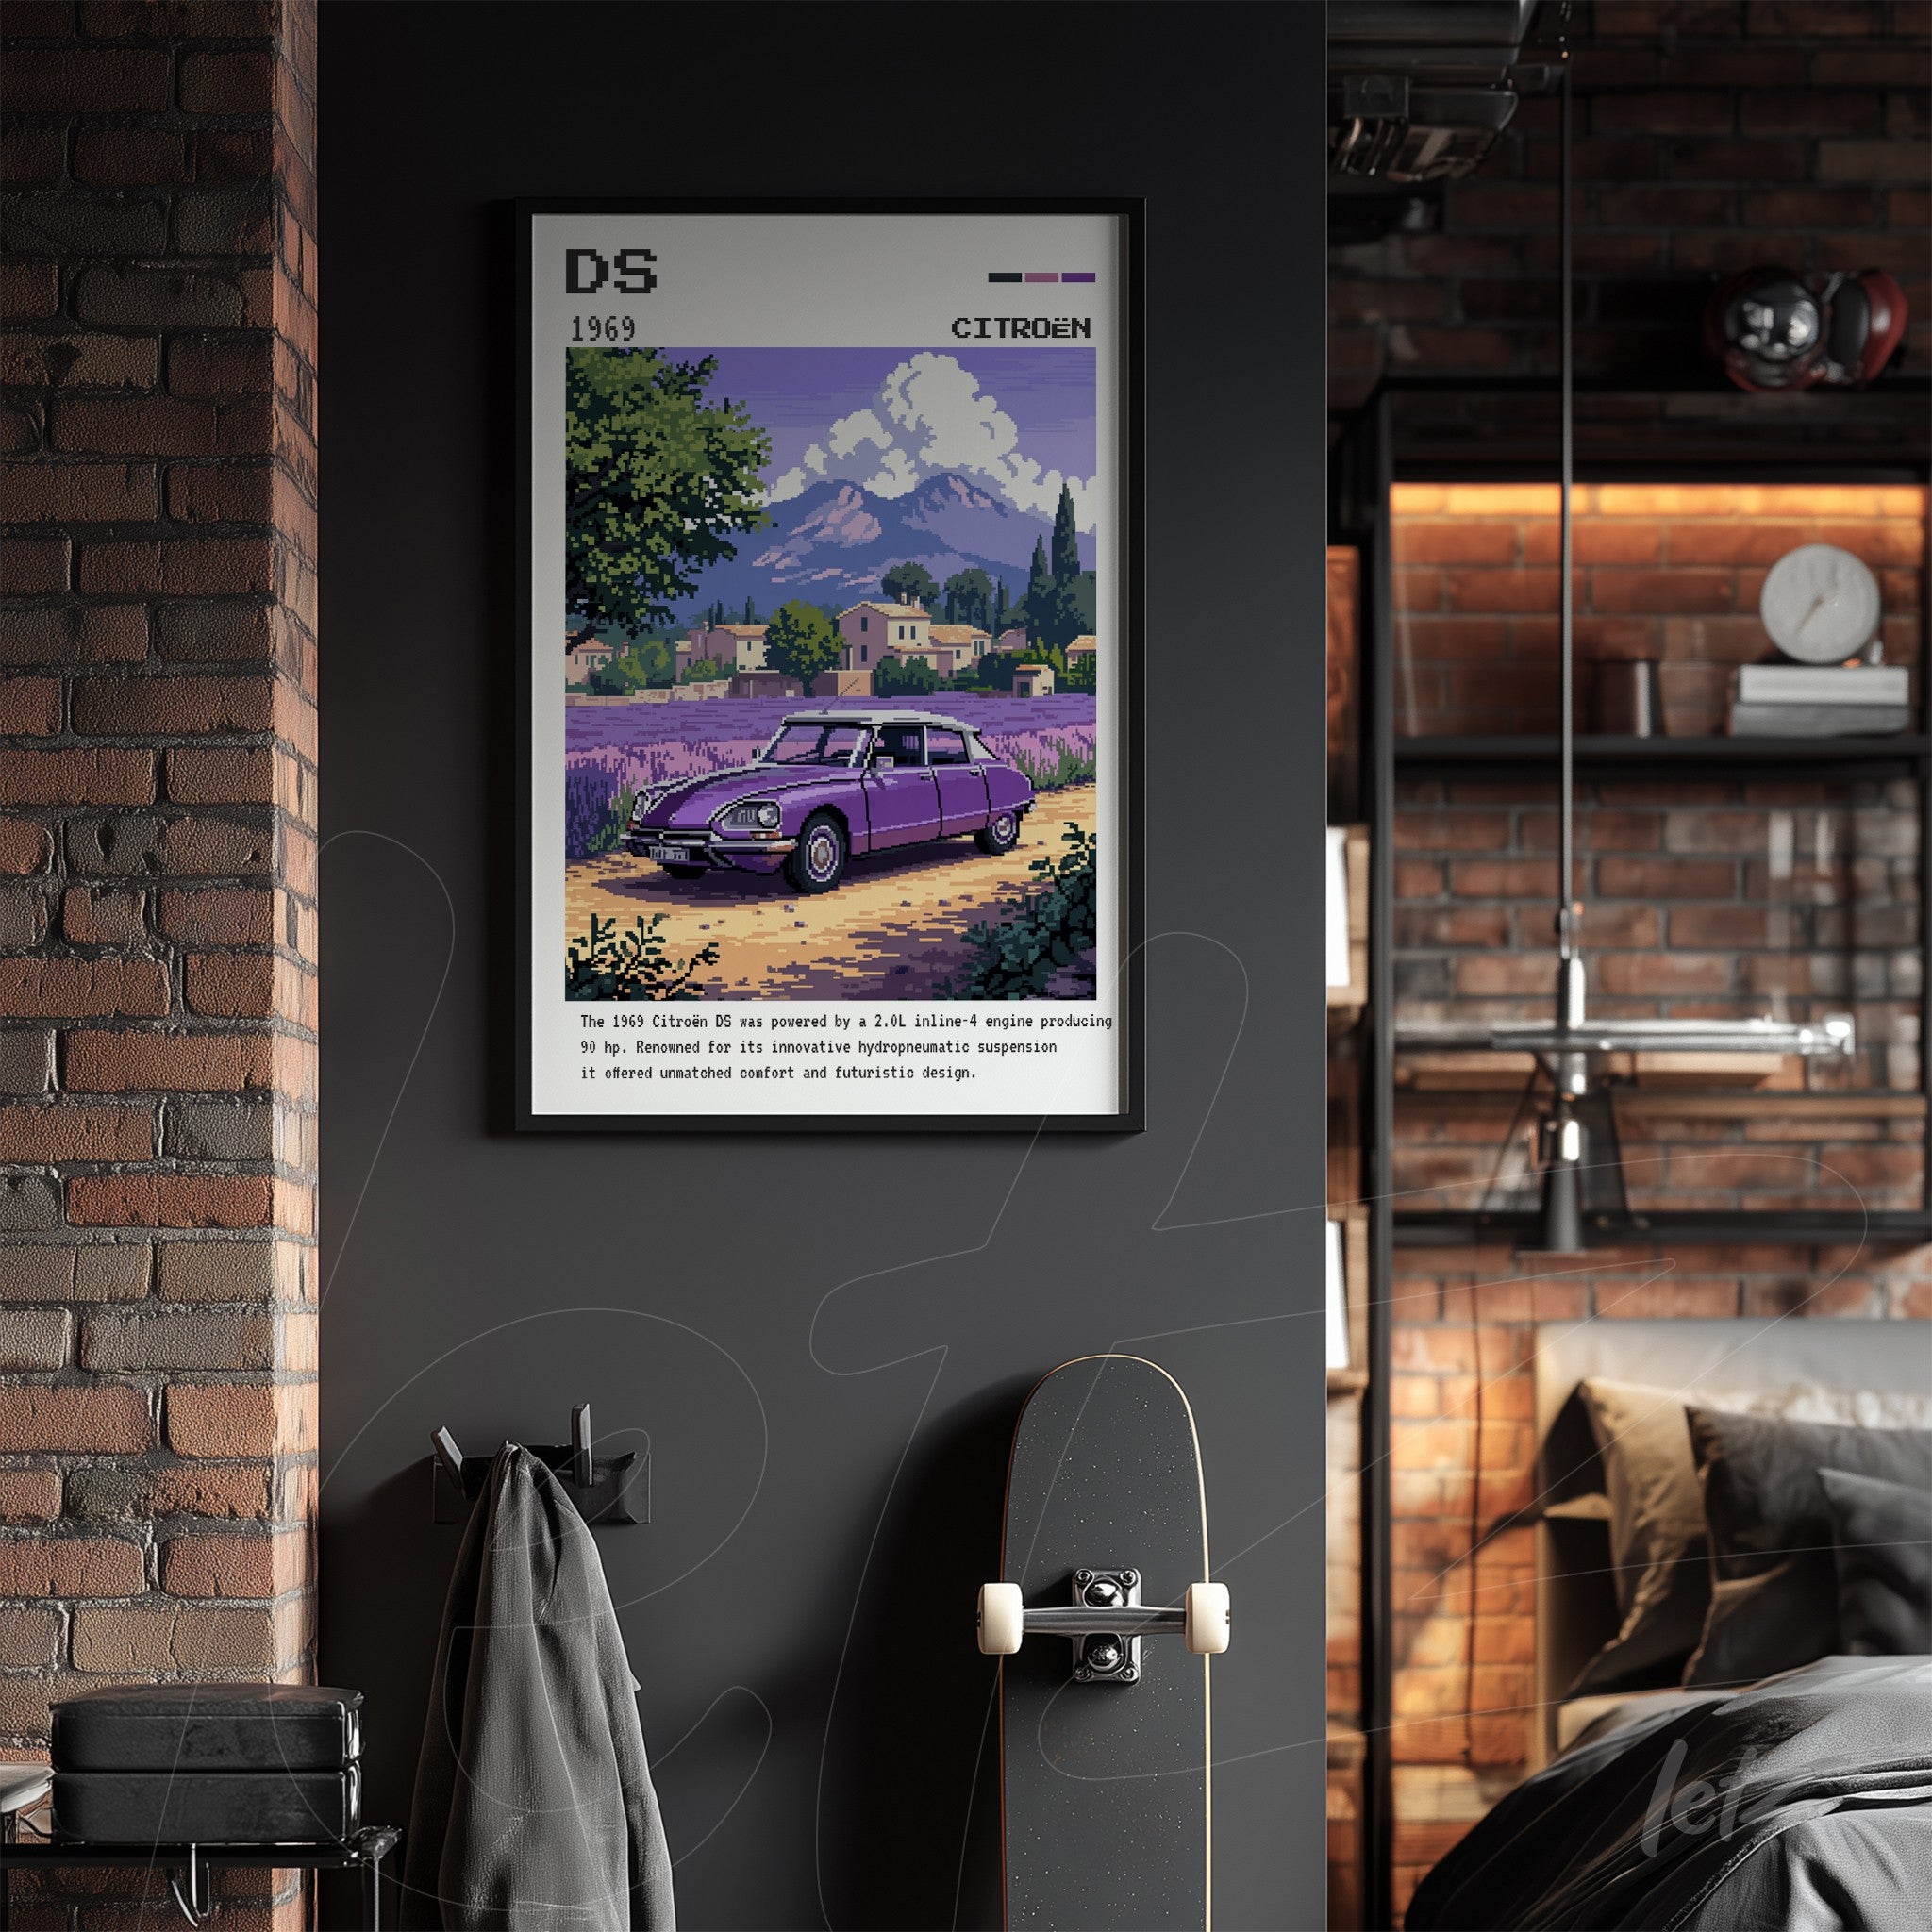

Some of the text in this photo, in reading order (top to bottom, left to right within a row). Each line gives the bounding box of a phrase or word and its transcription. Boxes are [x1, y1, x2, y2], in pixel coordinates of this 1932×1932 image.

[565, 248, 658, 294] DS
[572, 315, 636, 341] 1969
[580, 1013, 1113, 1031] The 1969 Citroën DS was powered by a 2.0L inline-4 engine producing
[580, 1040, 1058, 1058] 90 hp. Renowned for its innovative hydropneumatic suspension
[581, 1065, 975, 1082] it offered unmatched comfort and futuristic design.
